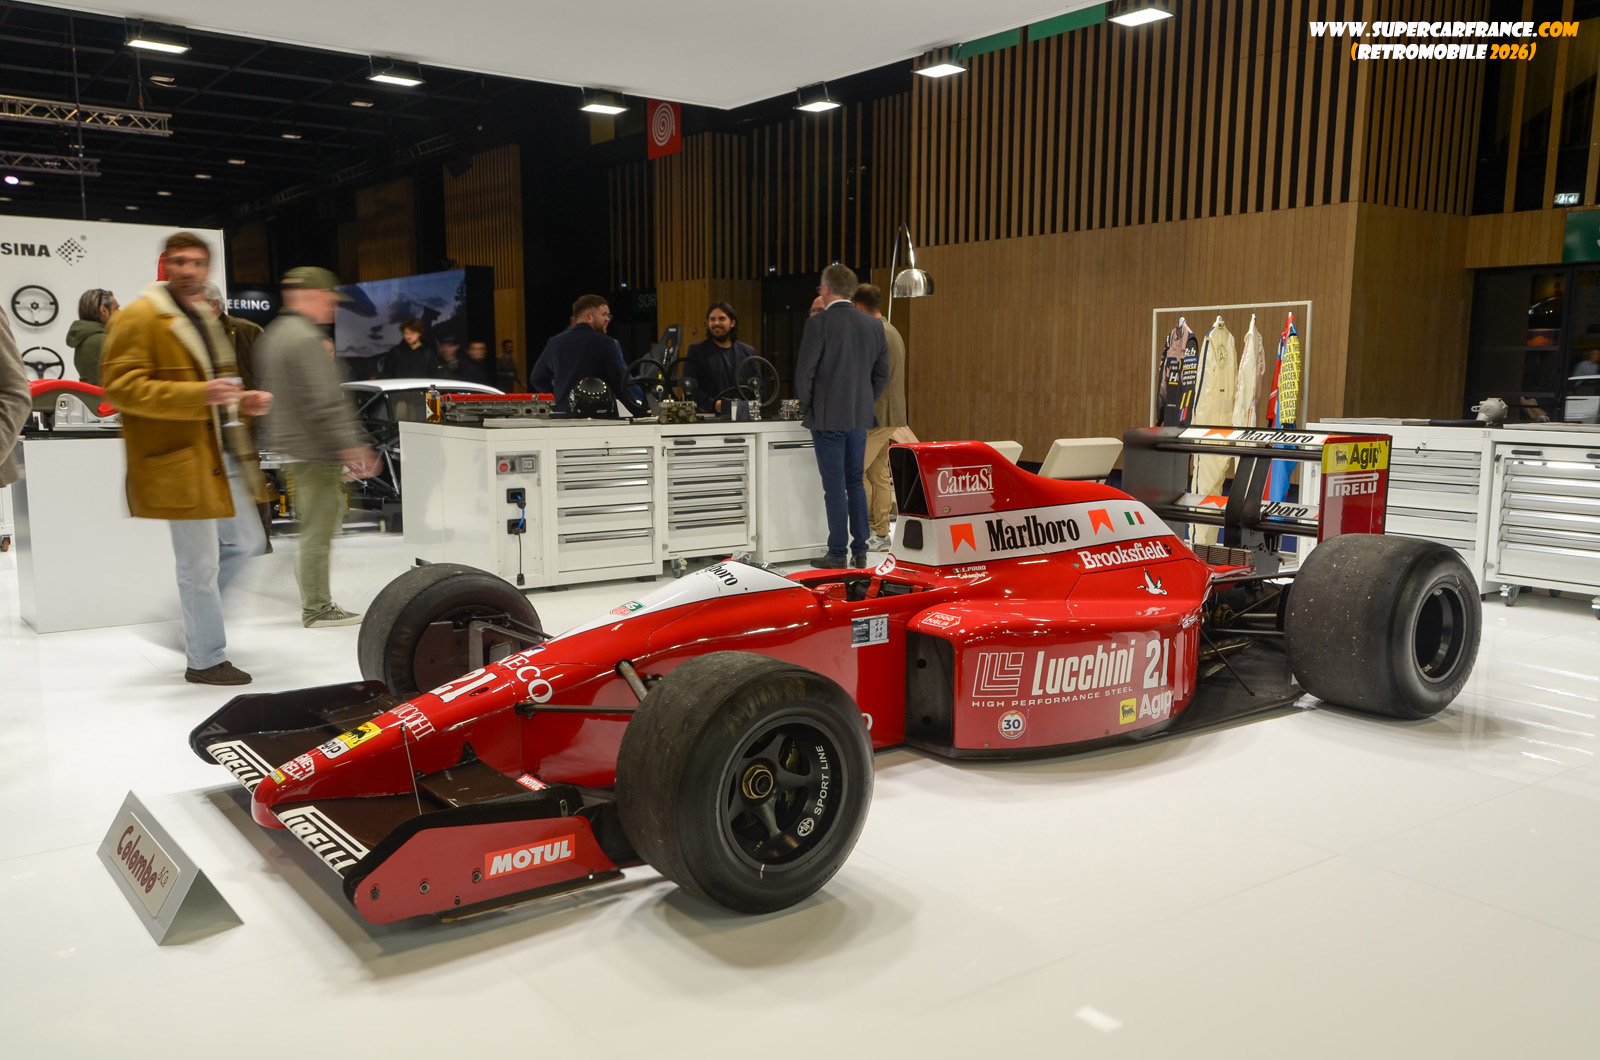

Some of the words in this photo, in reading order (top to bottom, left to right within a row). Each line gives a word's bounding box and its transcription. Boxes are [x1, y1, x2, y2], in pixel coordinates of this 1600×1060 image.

[0, 242, 51, 258] SINA
[1238, 430, 1314, 444] Marlboro
[1349, 443, 1380, 470] Agip
[985, 515, 1080, 552] Marlboro
[1077, 541, 1169, 569] Brooksfield
[1031, 640, 1136, 696] Lucchini
[1143, 638, 1170, 690] 21
[1012, 692, 1099, 707] PERFORMANCE
[1105, 686, 1133, 697] STEEL
[1138, 688, 1172, 719] Agip
[1003, 719, 1021, 730] 30
[815, 745, 829, 770] LINE
[519, 775, 544, 791] MOTUL
[814, 774, 829, 816] SPORT
[489, 840, 572, 875] MOTUL
